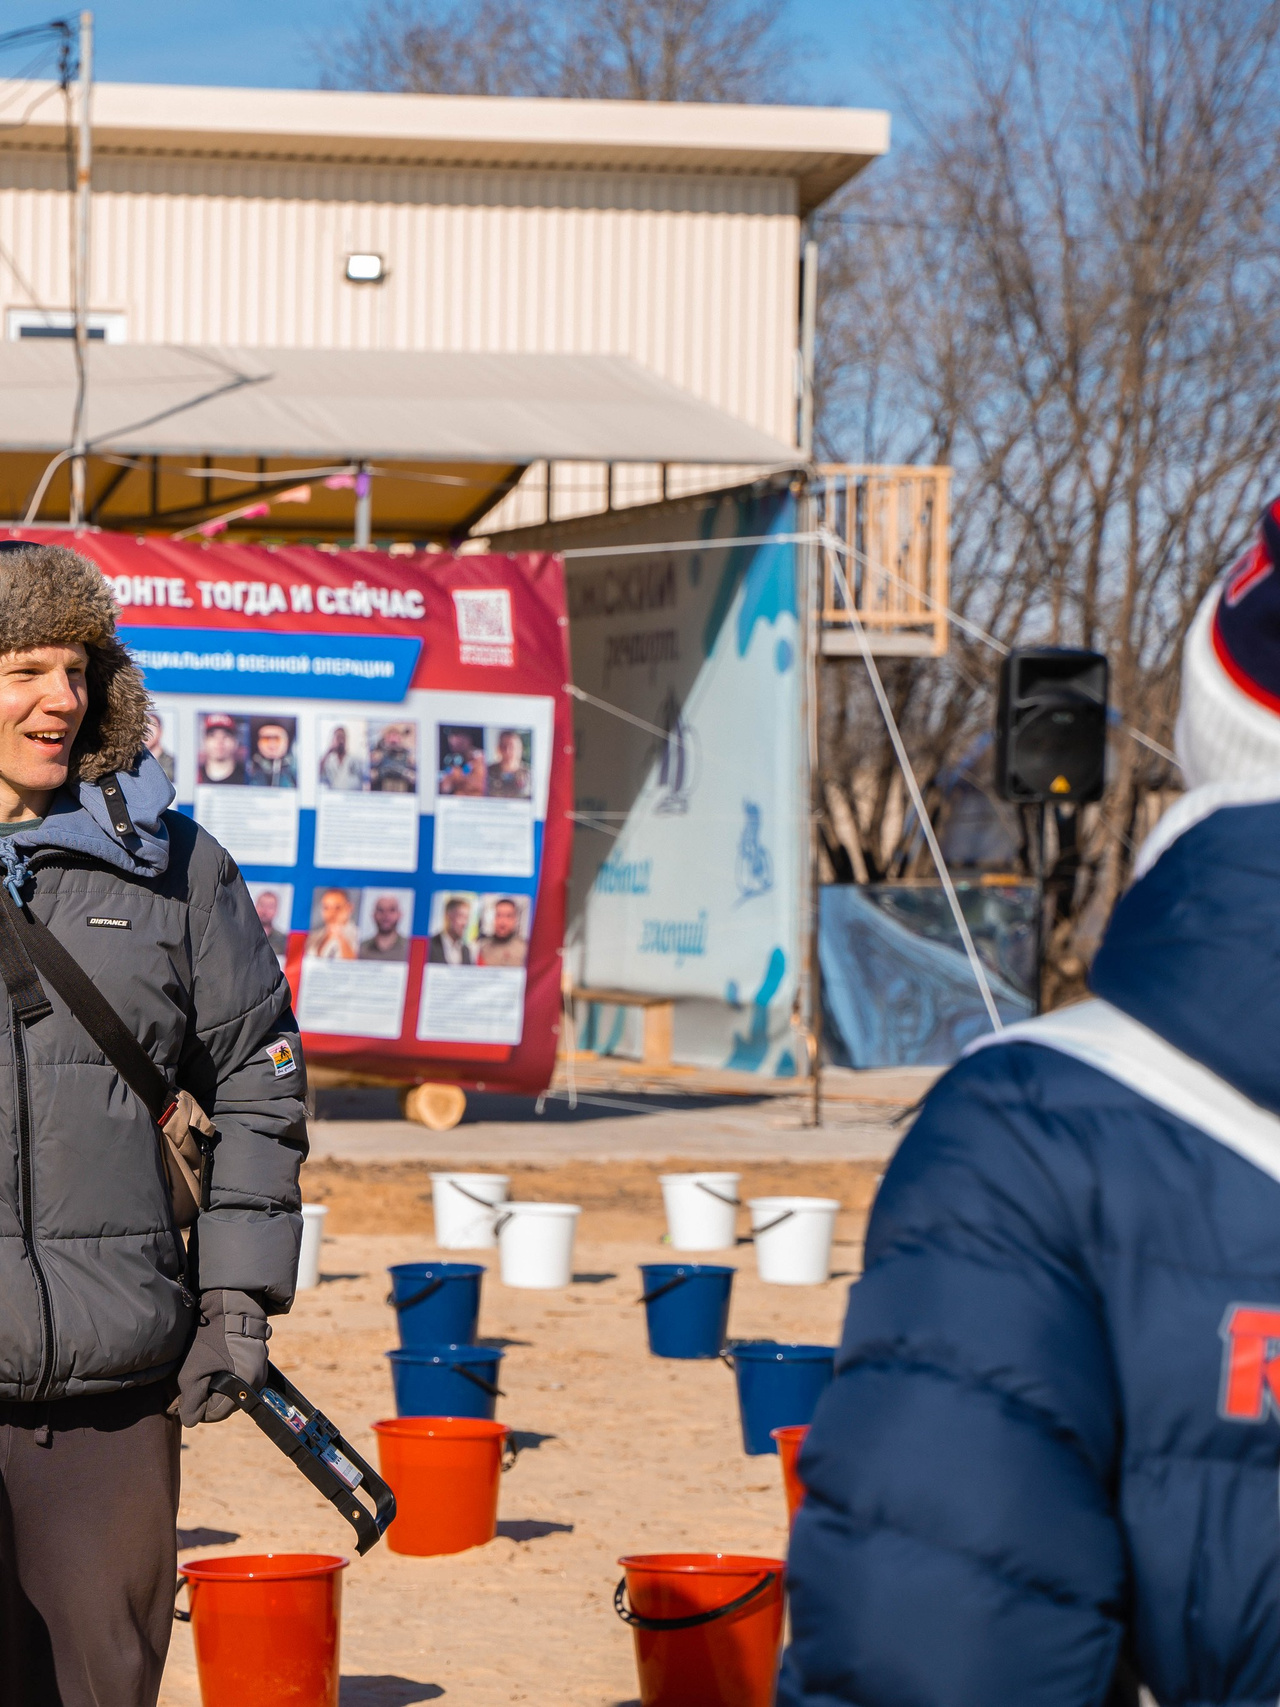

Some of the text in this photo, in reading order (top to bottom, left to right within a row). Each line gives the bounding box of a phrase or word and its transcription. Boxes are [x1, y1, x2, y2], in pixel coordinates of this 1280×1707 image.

[196, 580, 287, 616] ТОГДА
[290, 584, 313, 613] И
[317, 580, 425, 619] СЕЙЧАС
[236, 652, 310, 674] ВОЕННОЙ
[312, 656, 395, 678] ОПЕРАЦИИ
[90, 918, 128, 926] DISTANCE
